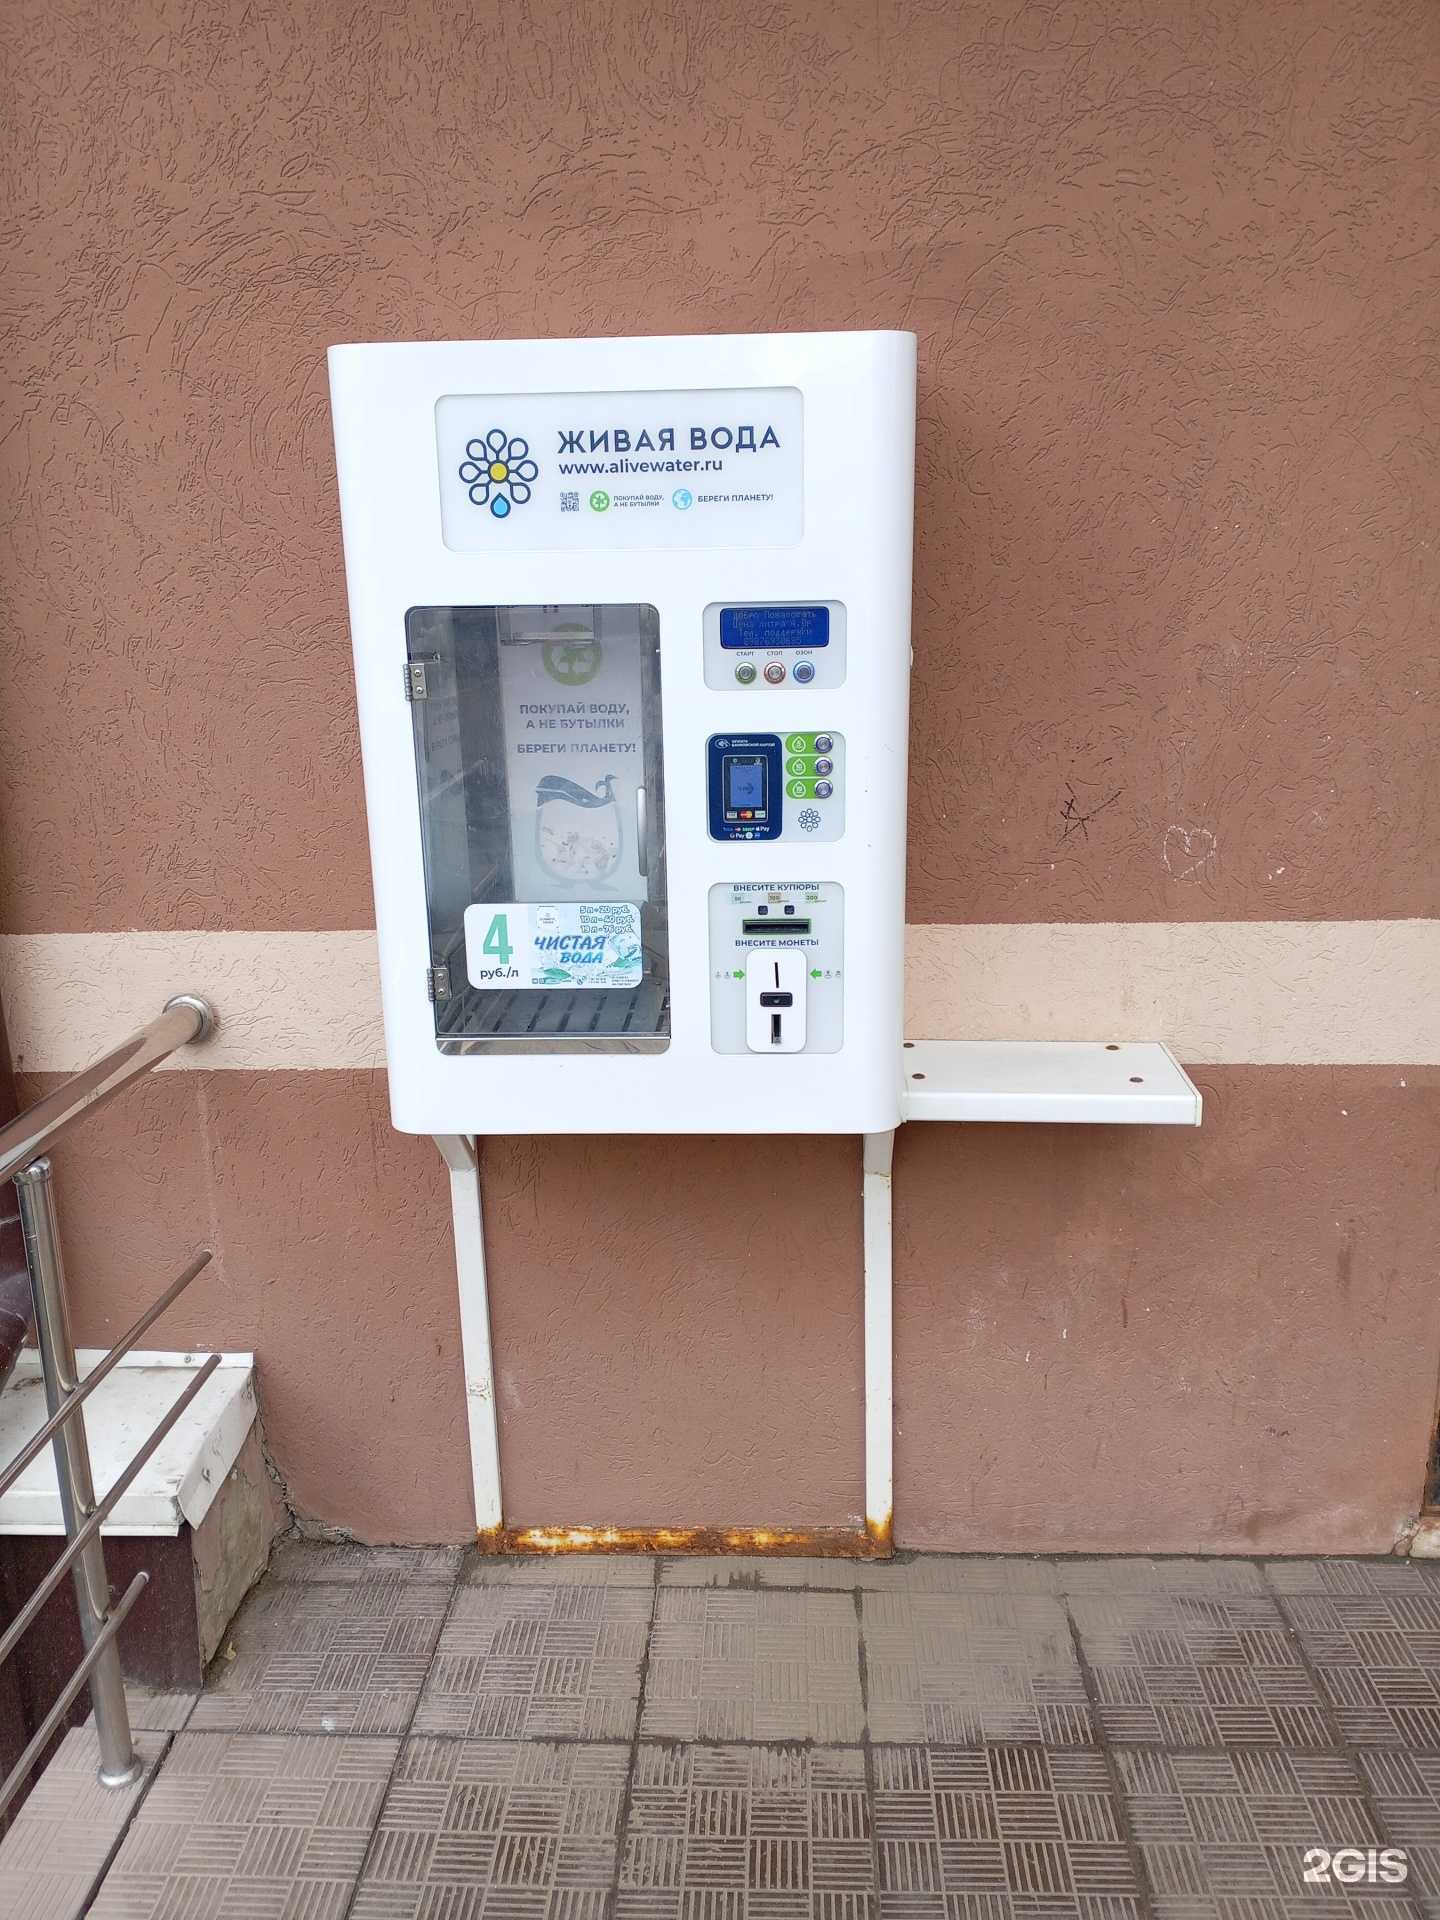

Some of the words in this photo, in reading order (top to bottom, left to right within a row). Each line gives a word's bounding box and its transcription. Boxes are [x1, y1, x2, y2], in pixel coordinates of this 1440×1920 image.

[557, 428, 675, 454] ЖИВАЯ
[690, 425, 781, 453] ВОДА
[558, 458, 723, 475] www.alivewater.ru
[732, 494, 774, 502] ПЛАНЕТУ!
[519, 702, 586, 715] ПОКУПАЙ
[589, 704, 630, 715] ВОДУ,
[526, 720, 536, 729] А
[539, 720, 557, 729] НЕ
[560, 719, 625, 729] БУТЫЛКИ
[517, 744, 567, 753] БЕРЕГИ
[571, 743, 636, 753] ПЛАНЕТУ!
[733, 884, 775, 892] ВНЕСИТЕ
[777, 883, 820, 891] КУПЮРЫ
[483, 914, 513, 964] 4
[534, 935, 607, 950] ЧИСТАЯ
[735, 939, 776, 947] ВНЕСИТЕ
[778, 939, 819, 947] МОНЕТЫ
[559, 952, 604, 964] ВОДА
[480, 967, 519, 979] руб./л
